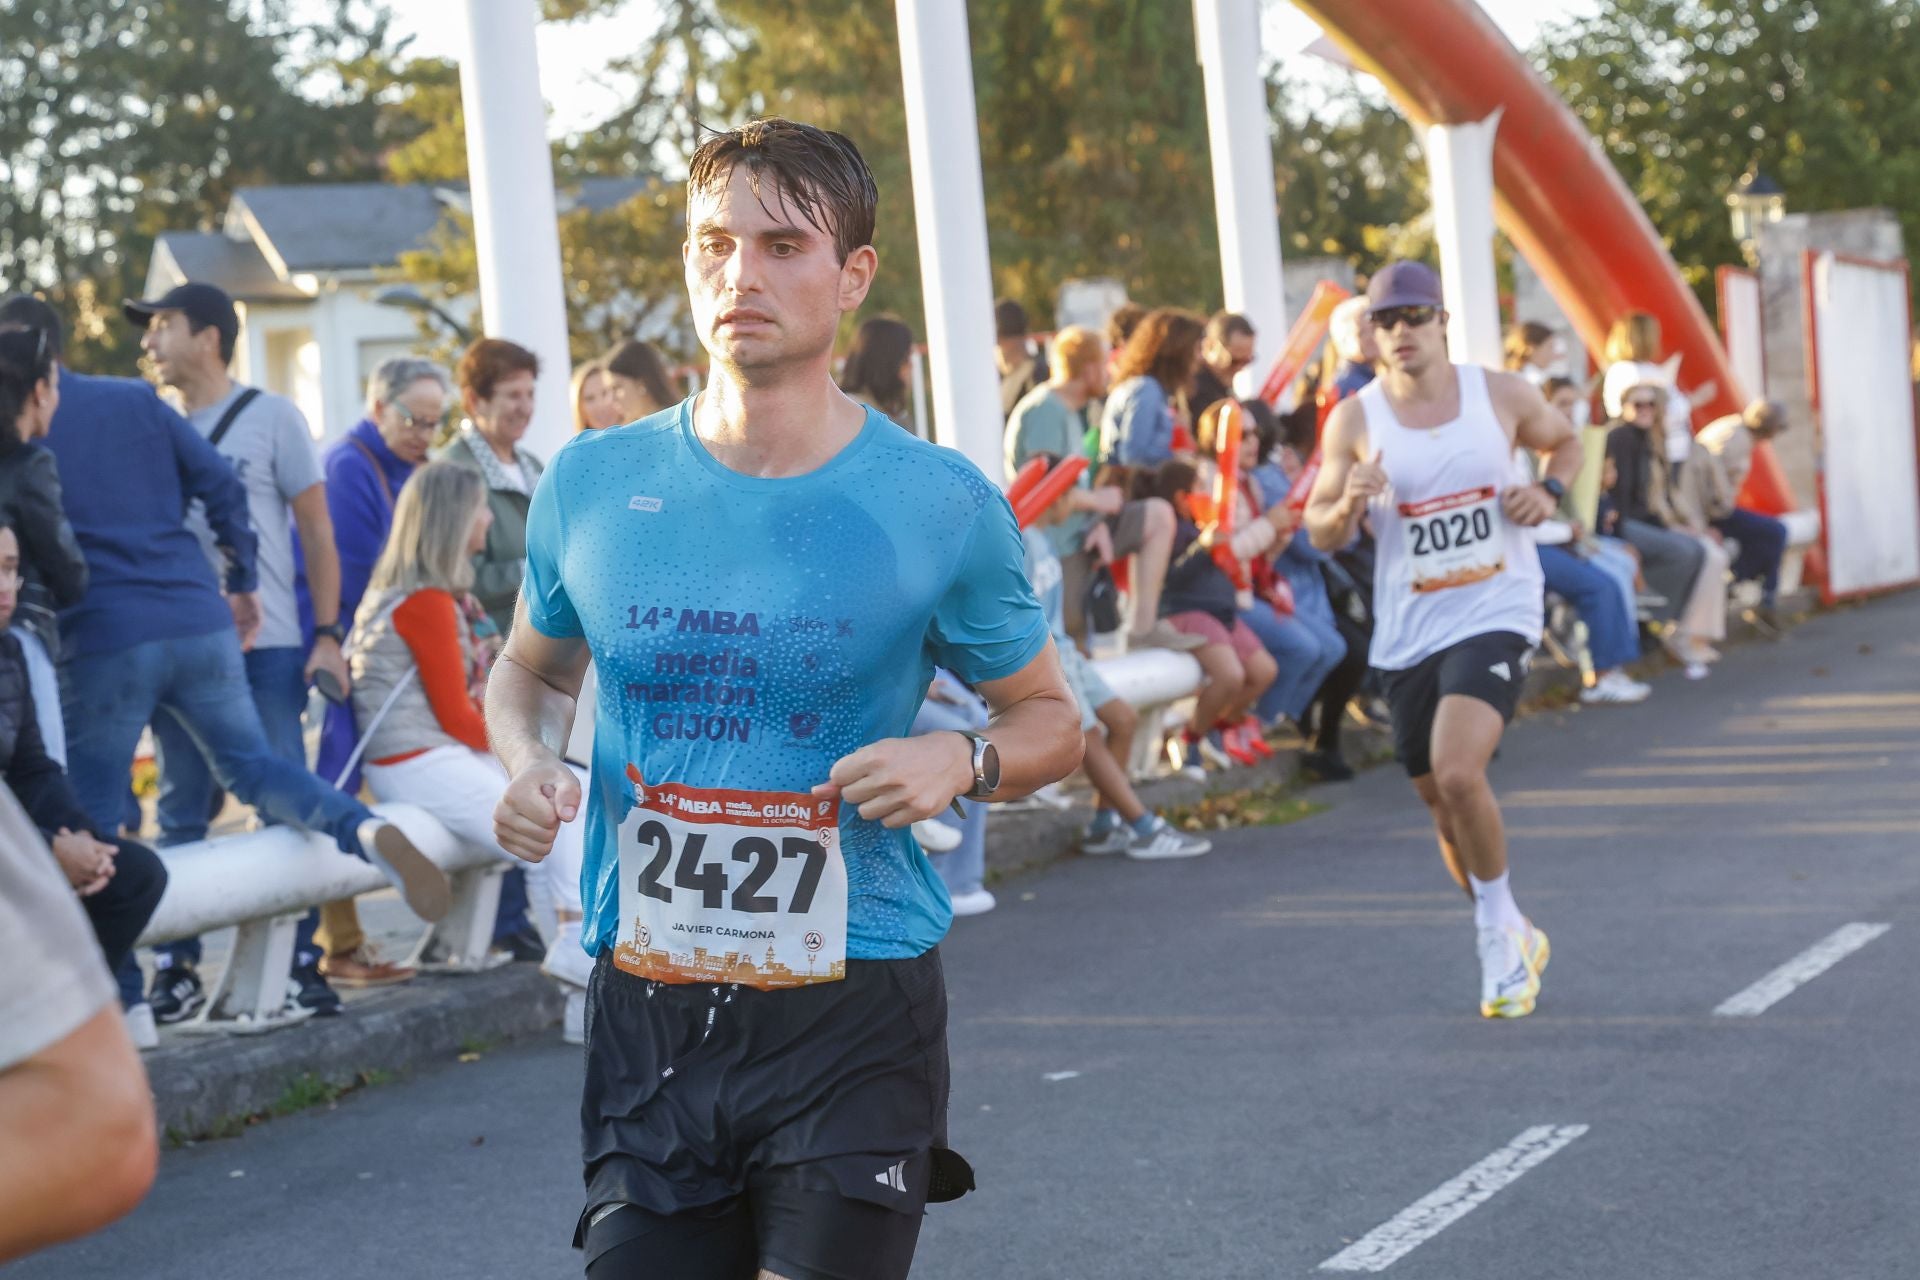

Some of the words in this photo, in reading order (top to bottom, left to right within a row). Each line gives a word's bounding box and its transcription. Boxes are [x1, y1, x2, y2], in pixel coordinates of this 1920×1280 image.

[632, 499, 660, 510] 42K
[1410, 508, 1491, 556] 2020
[676, 608, 760, 637] MBA
[655, 648, 757, 678] media
[624, 679, 756, 707] maratón
[653, 709, 751, 743] GIJÓN
[678, 796, 723, 815] MBA
[726, 801, 753, 810] media
[726, 807, 761, 818] maratón
[762, 802, 812, 821] GIJÓN
[637, 820, 827, 914] 2427
[672, 922, 713, 935] JAVIER
[715, 926, 776, 939] CARMONA
